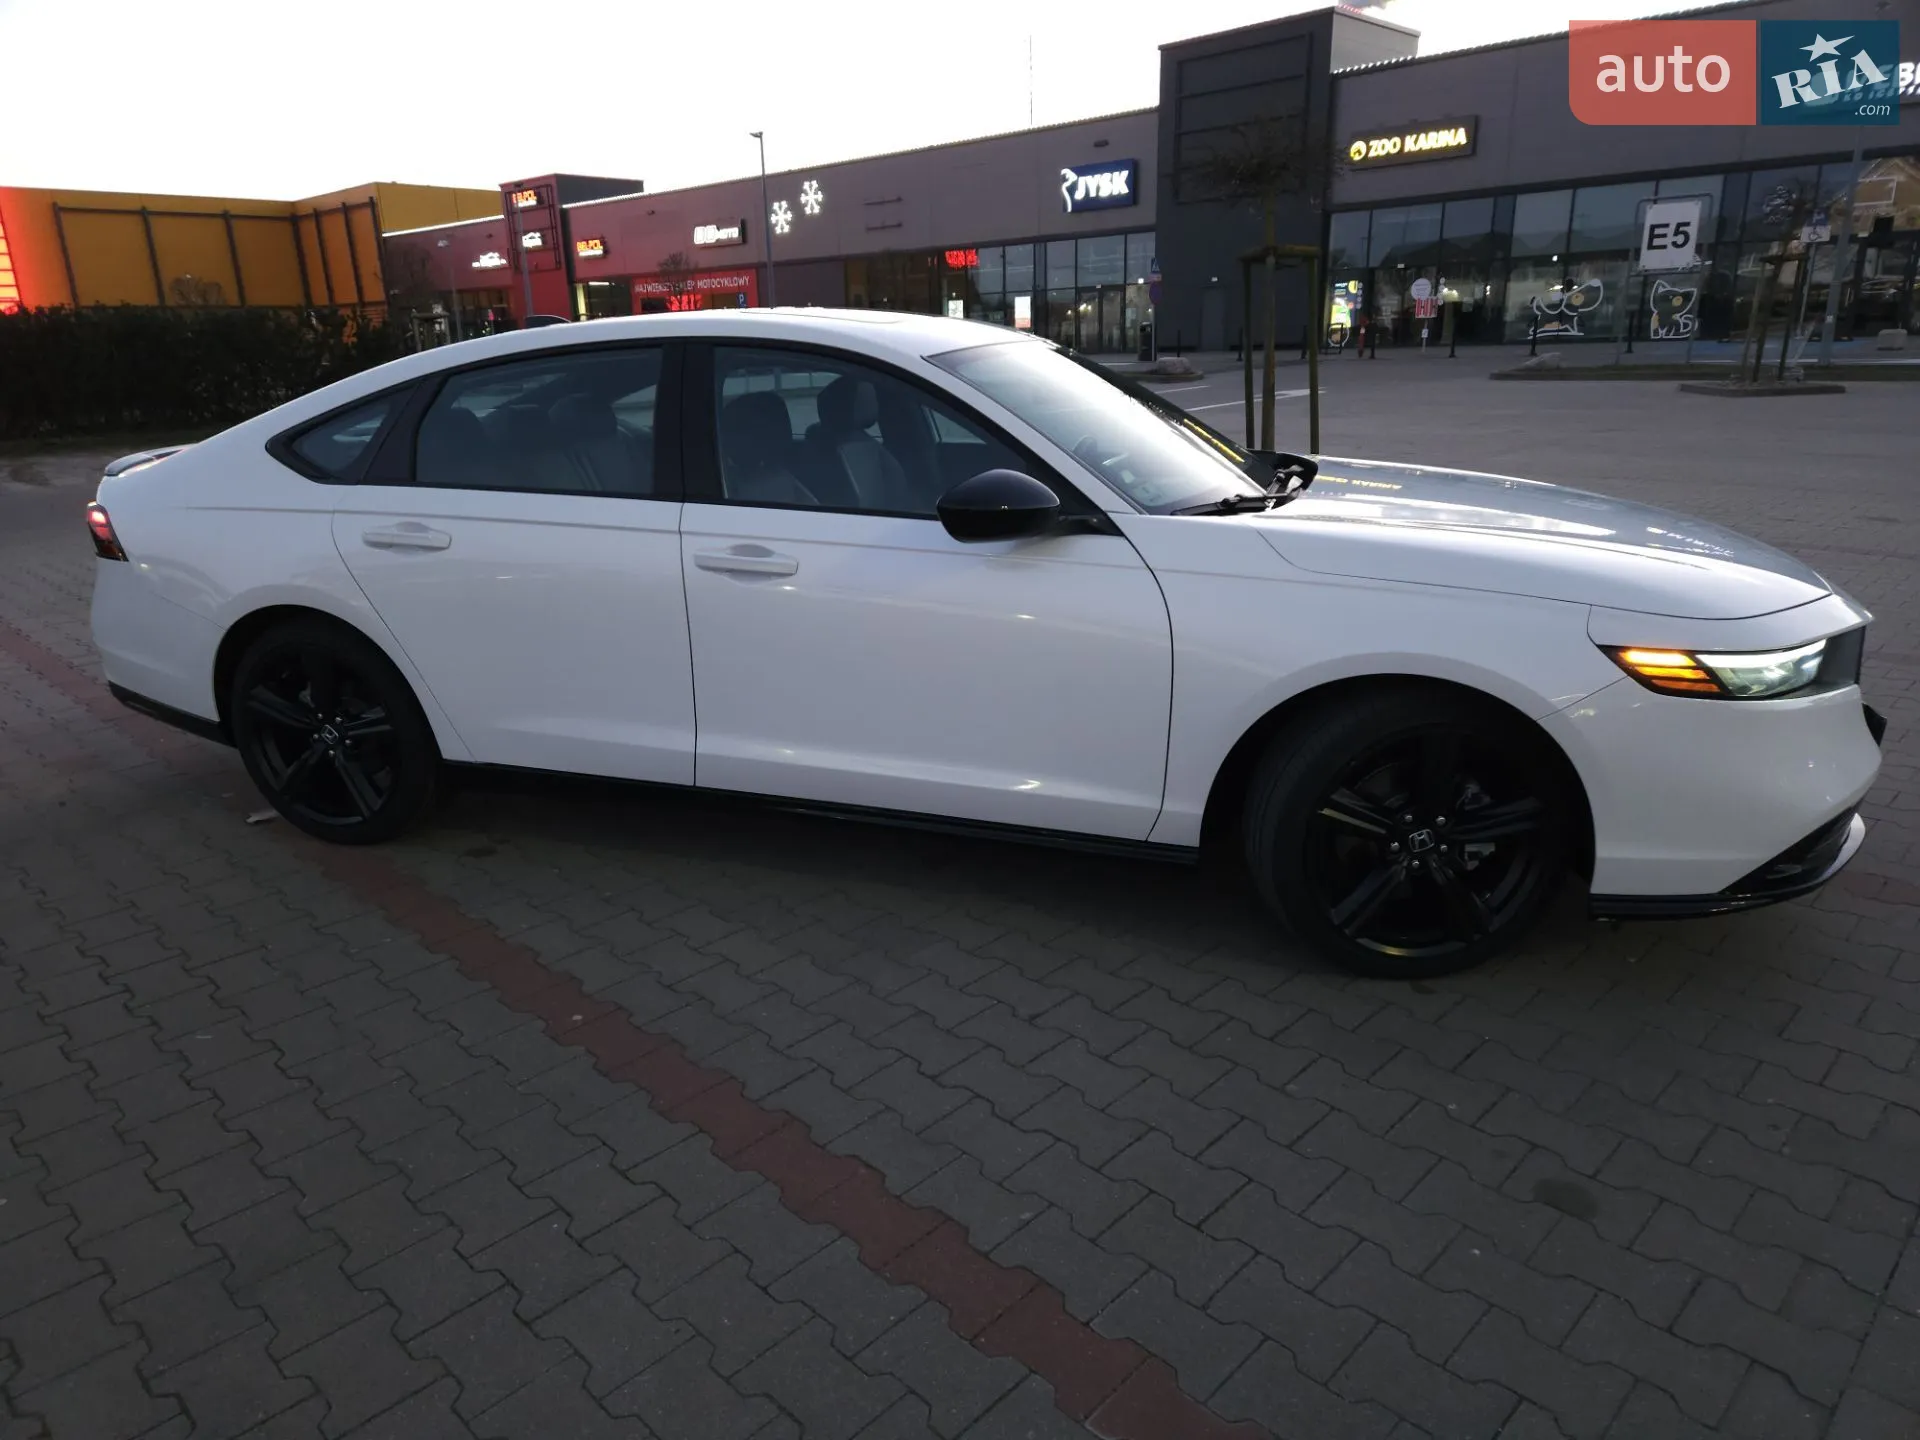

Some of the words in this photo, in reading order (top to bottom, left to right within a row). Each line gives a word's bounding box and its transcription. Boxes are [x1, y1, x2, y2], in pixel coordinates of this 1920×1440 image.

[1367, 136, 1402, 158] ZOO
[1404, 127, 1467, 153] KARINA
[1074, 170, 1129, 200] JYSK
[1647, 221, 1691, 251] E5
[697, 275, 750, 289] MOTOCYKLOWY
